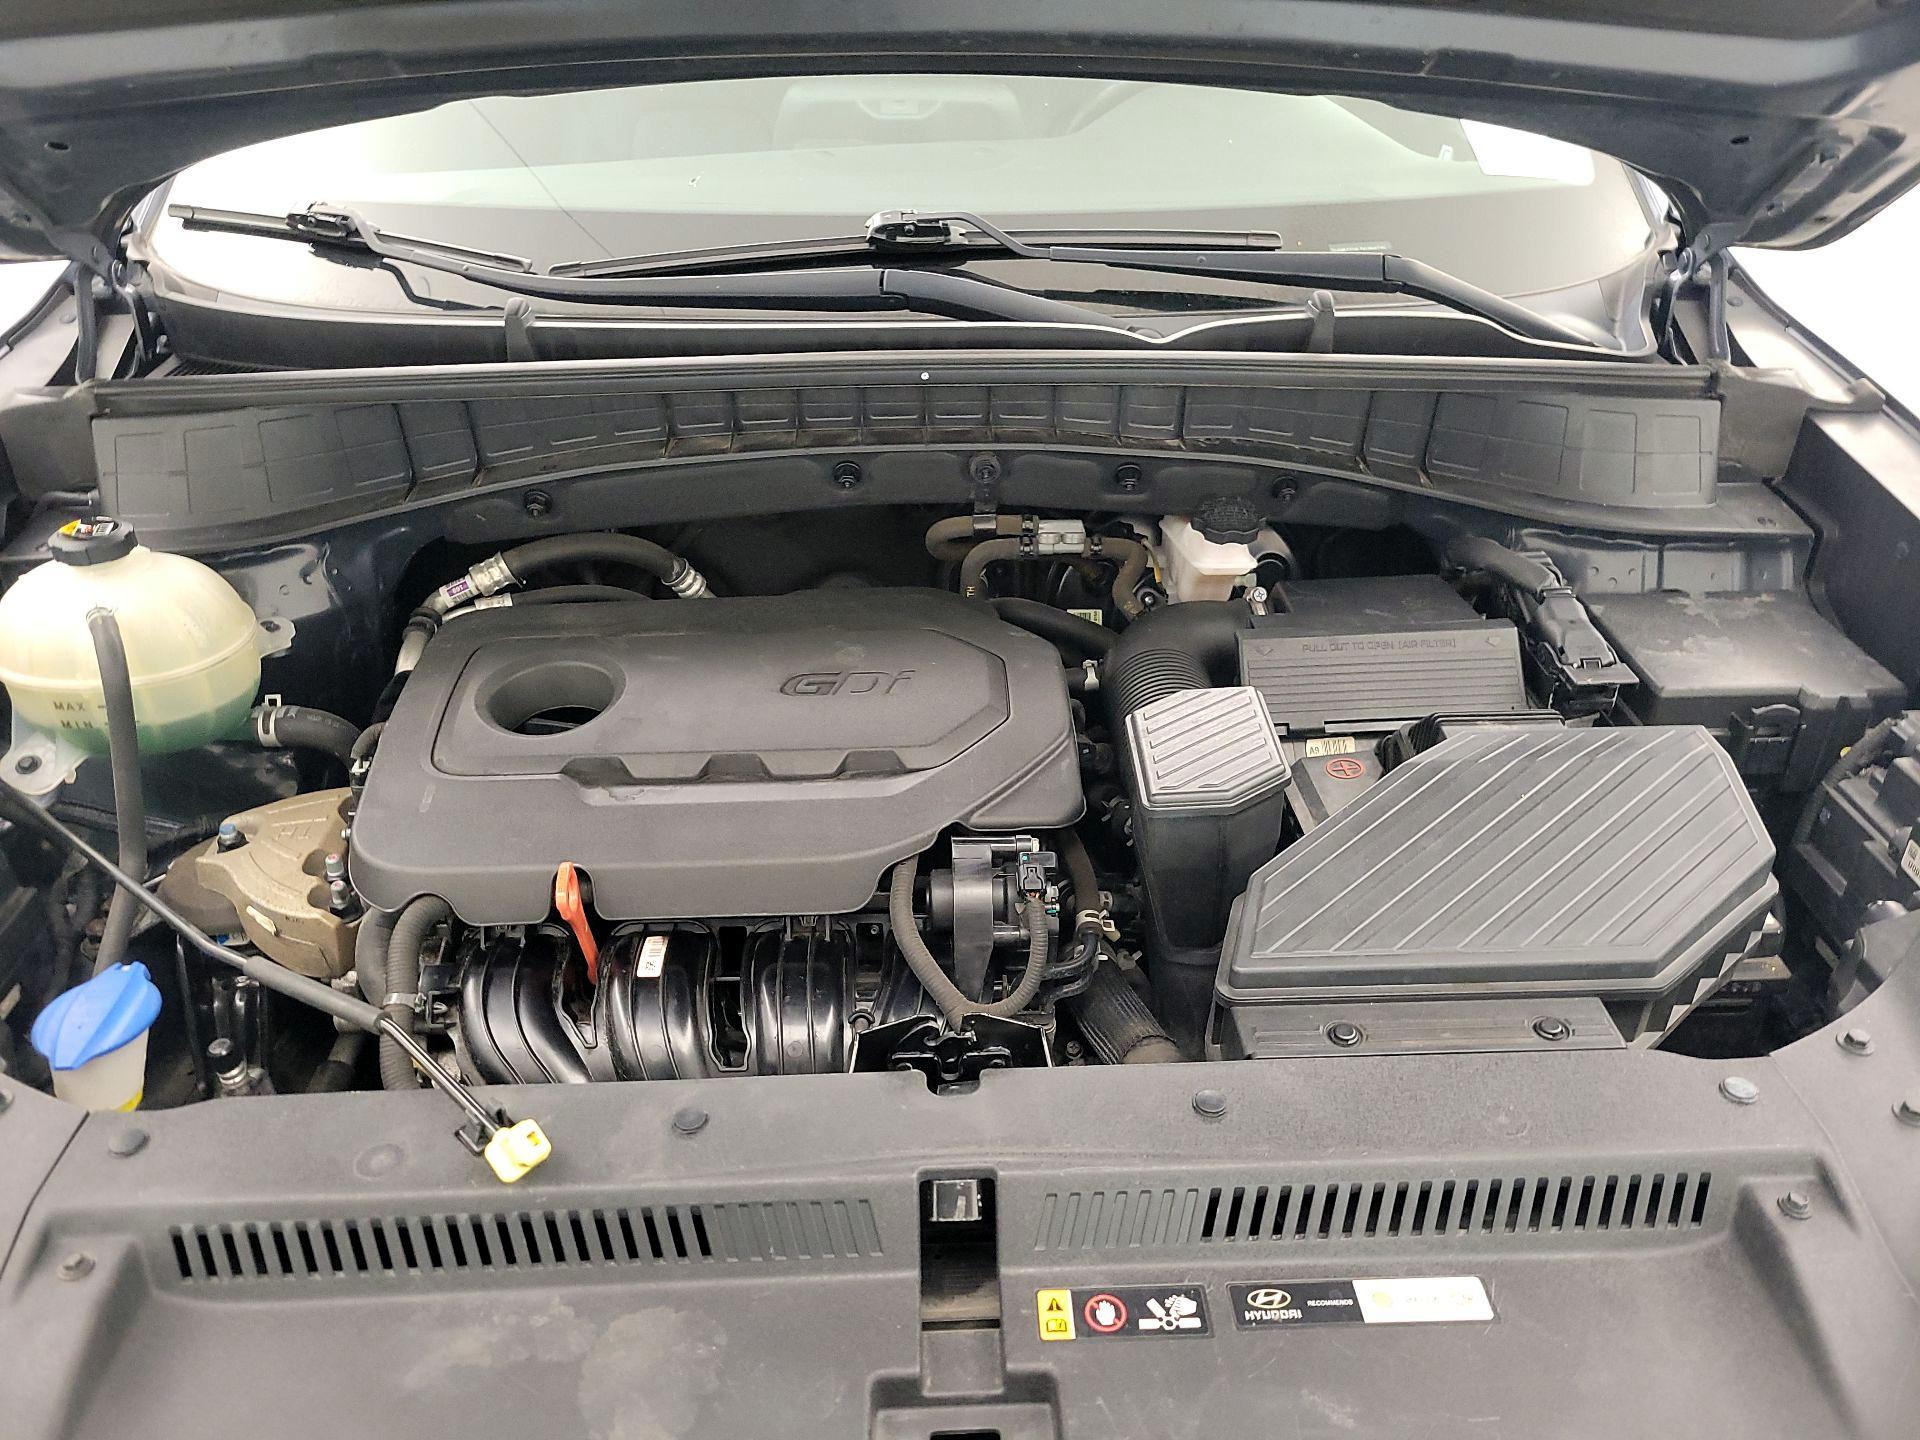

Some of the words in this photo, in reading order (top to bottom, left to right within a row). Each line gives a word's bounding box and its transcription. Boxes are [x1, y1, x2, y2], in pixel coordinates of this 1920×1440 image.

[1302, 643, 1327, 653] PULL
[1330, 642, 1349, 652] OUT
[1352, 641, 1365, 650] TO
[1367, 641, 1394, 650] OPEN
[53, 701, 85, 711] MAX
[61, 720, 93, 729] MIN
[1307, 1298, 1354, 1307] RECOMMENDS
[1244, 1309, 1303, 1321] HYUNDAI
